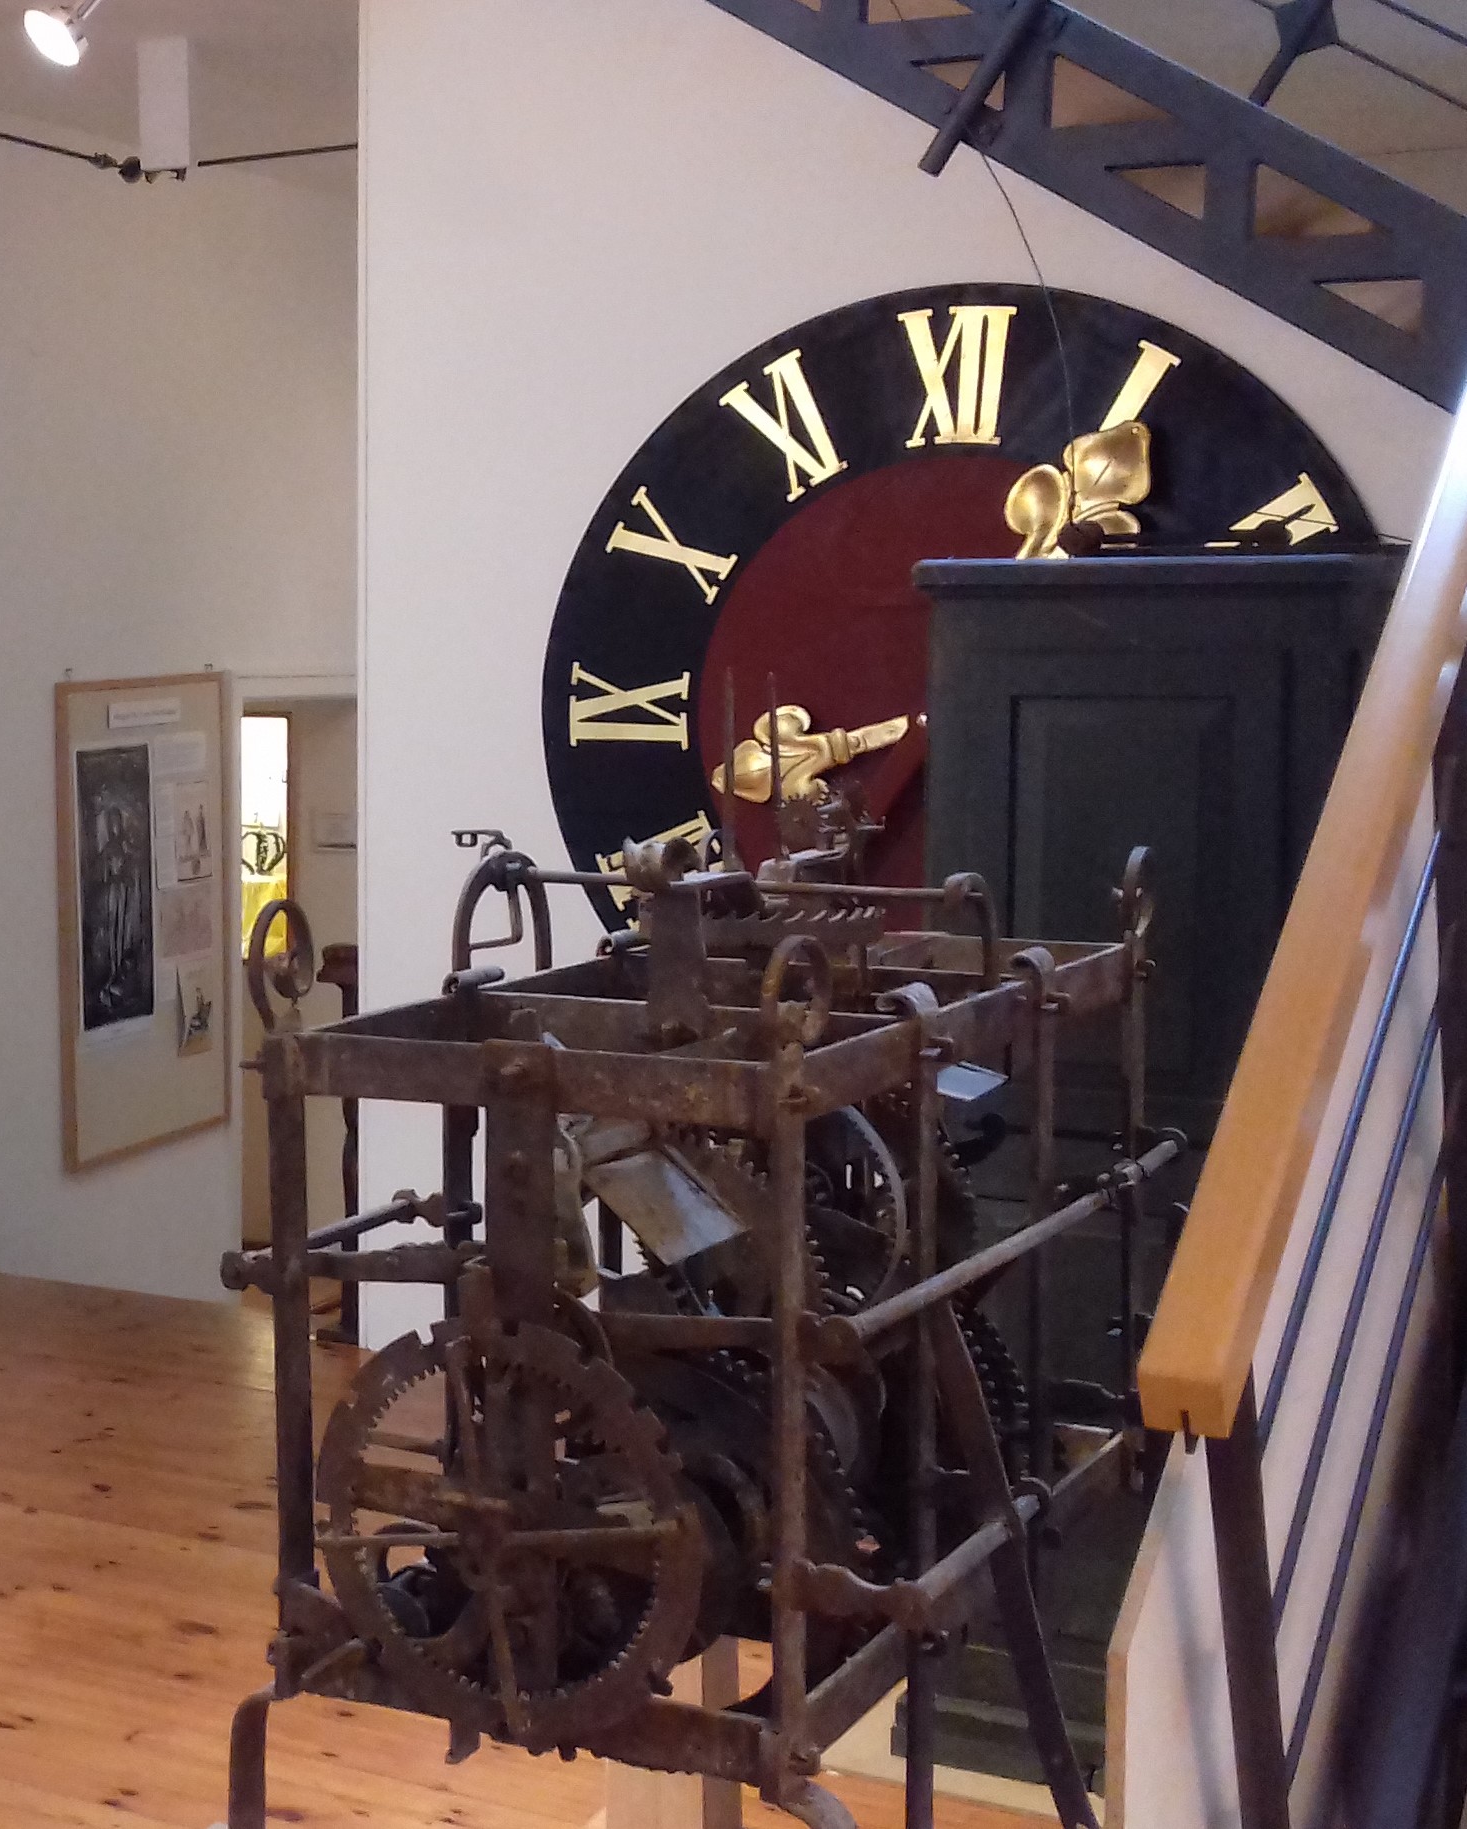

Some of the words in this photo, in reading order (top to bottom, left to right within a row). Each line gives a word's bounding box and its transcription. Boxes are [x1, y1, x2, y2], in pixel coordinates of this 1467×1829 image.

[719, 347, 849, 503] XI
[897, 305, 1018, 448] XII
[605, 485, 738, 605] X
[569, 661, 690, 751] IX
